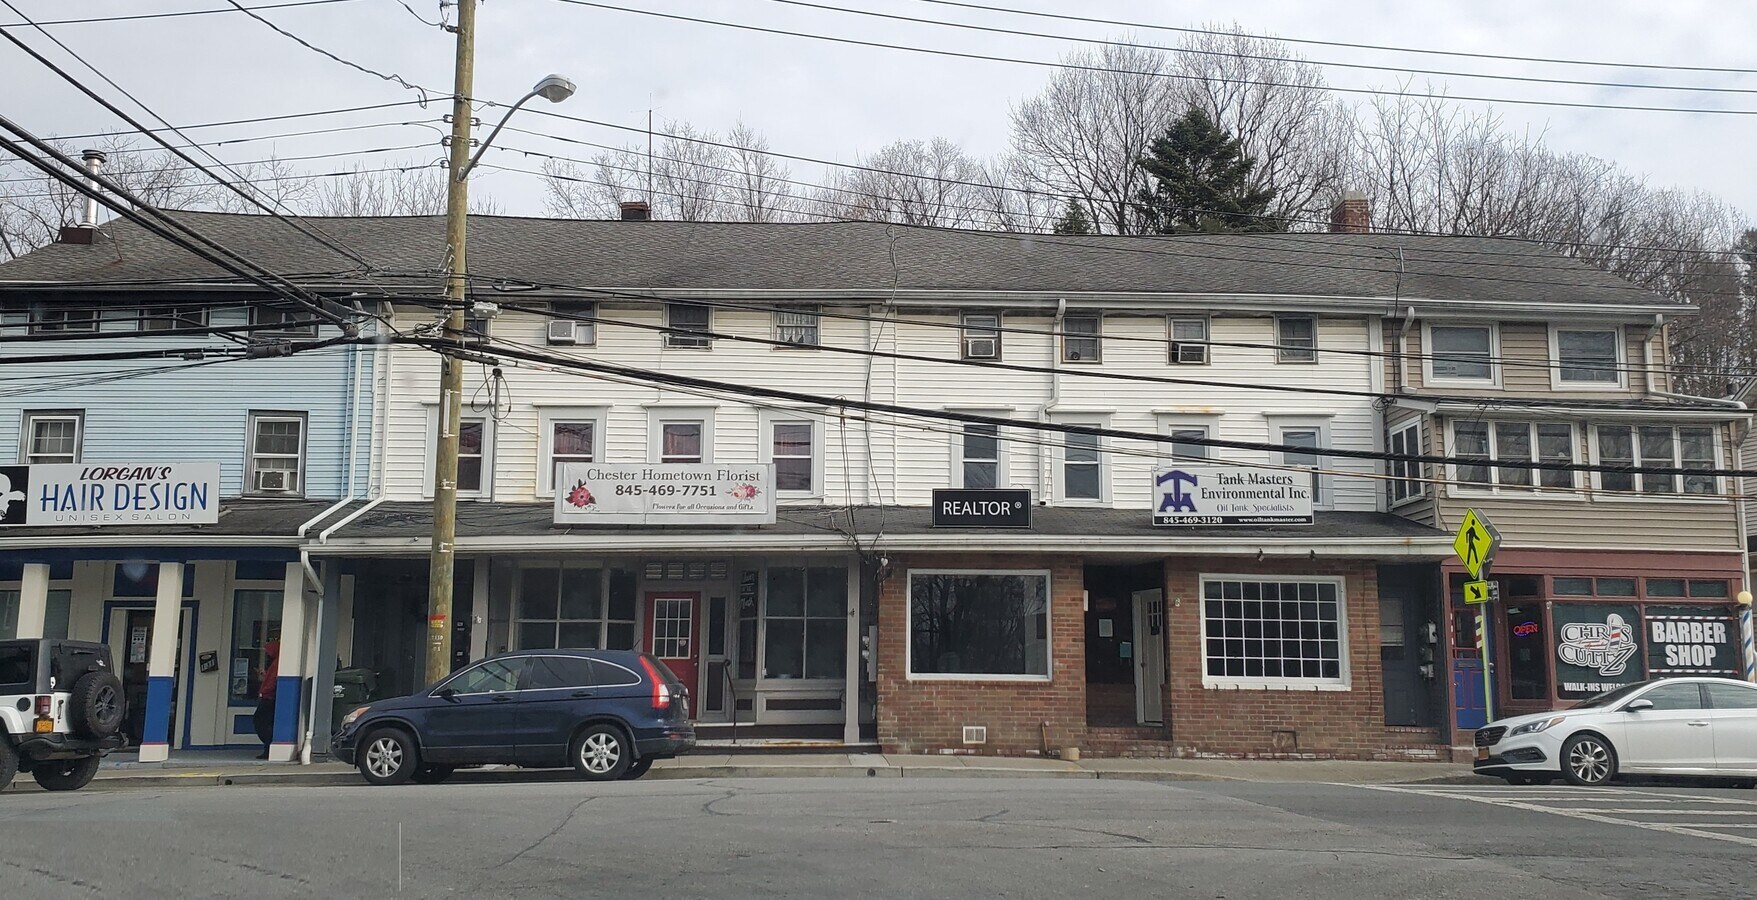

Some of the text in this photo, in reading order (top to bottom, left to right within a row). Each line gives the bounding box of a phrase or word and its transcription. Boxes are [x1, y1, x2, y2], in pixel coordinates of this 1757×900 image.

[79, 466, 172, 481] LORGAN'S
[587, 468, 761, 482] Chester Hometown Florist
[1216, 472, 1293, 485] Tank Masters
[40, 482, 208, 511] HAIR DESIGN
[615, 484, 717, 497] 845-469-7751
[1201, 487, 1310, 500] Environmental Inc.
[943, 501, 1011, 516] REALTOR
[1216, 503, 1295, 514] Oil Tank Specialists
[55, 513, 192, 522] UNISEX SALON
[1163, 516, 1223, 524] 845-469-3120
[1513, 624, 1538, 634] OPEN
[1652, 622, 1727, 644] BARBER
[1558, 643, 1637, 676] CUTTZ
[1666, 645, 1716, 666] SHOP
[1563, 682, 1600, 692] WALK-INS
